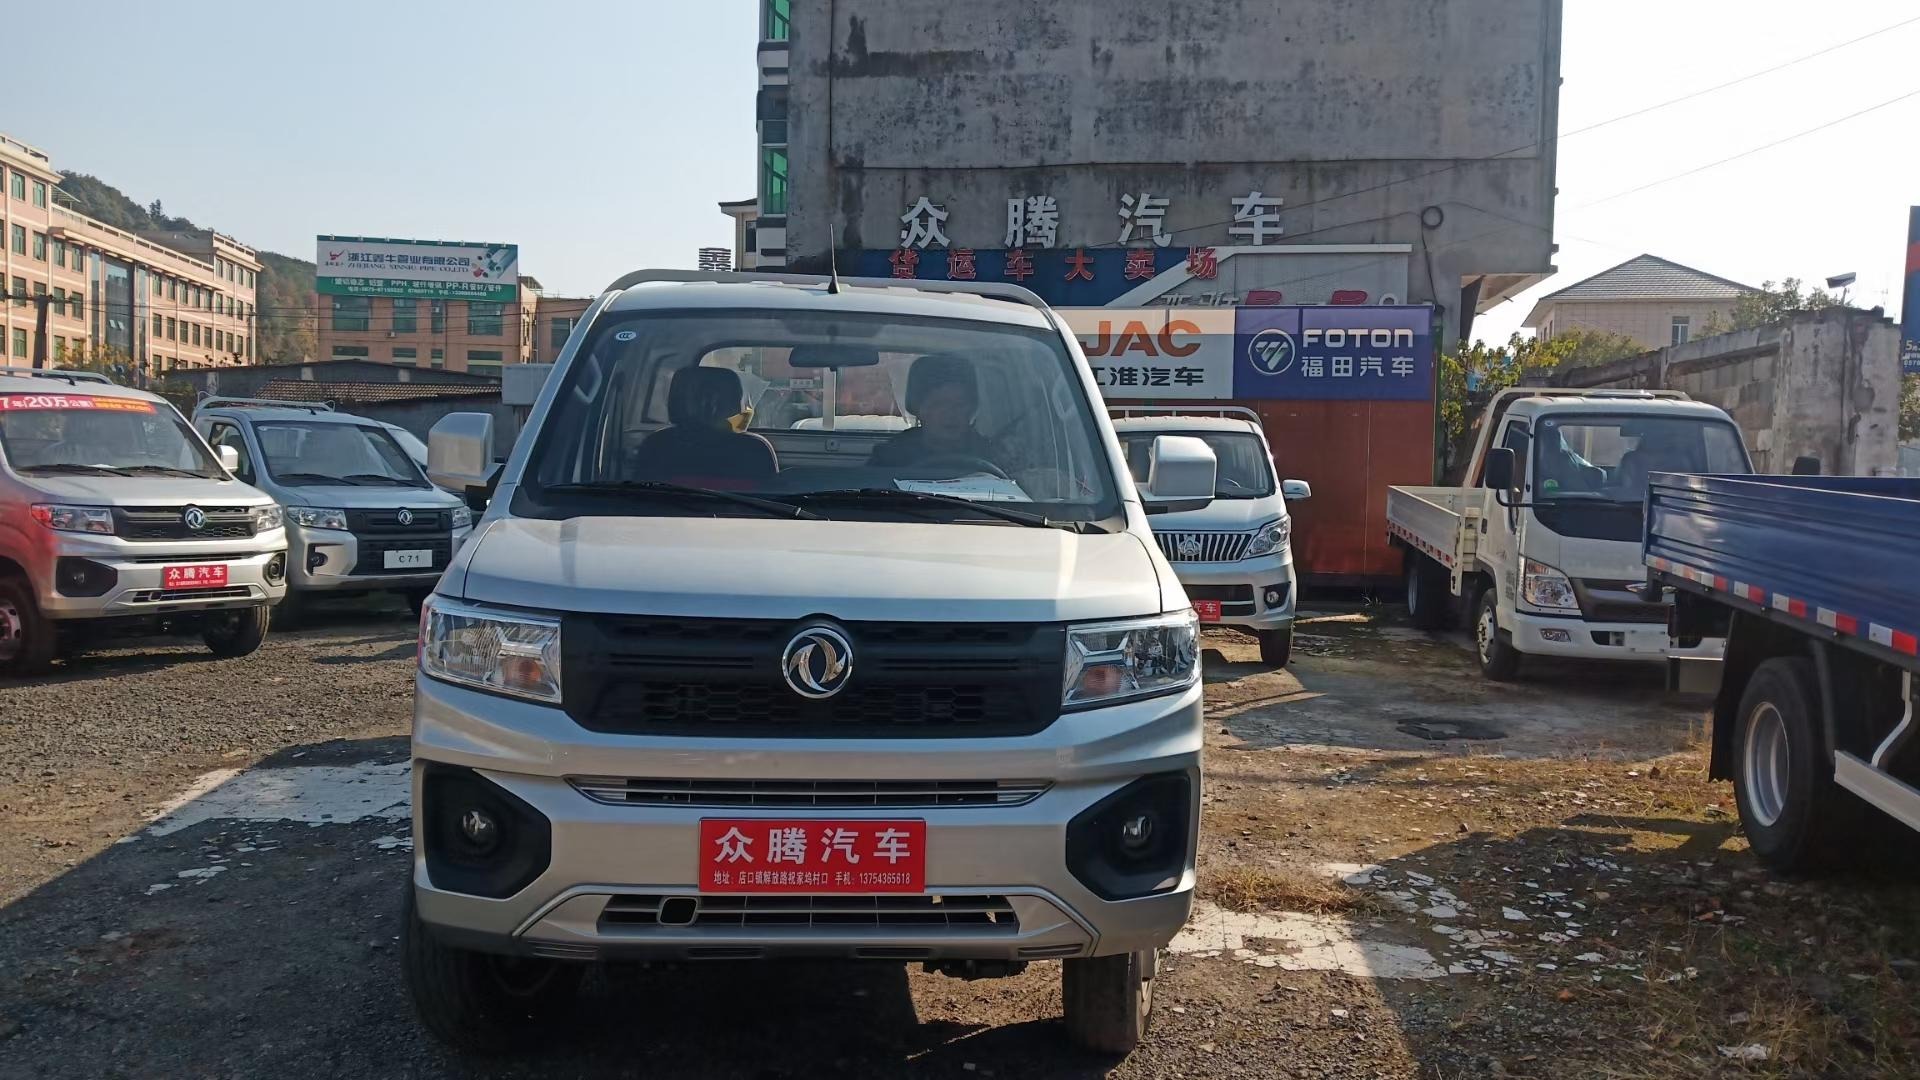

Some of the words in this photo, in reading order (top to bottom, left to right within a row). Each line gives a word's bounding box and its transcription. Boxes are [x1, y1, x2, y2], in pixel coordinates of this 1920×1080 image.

[900, 190, 1284, 249] 众腾汽车
[887, 247, 1219, 282] 货运车大卖场
[1078, 319, 1202, 357] JAC
[1302, 328, 1414, 348] FOTON
[1301, 356, 1414, 377] 福田汽车
[168, 565, 225, 580] 众腾汽车
[713, 826, 911, 865] 众腾汽车
[858, 872, 911, 885] 13754365618
